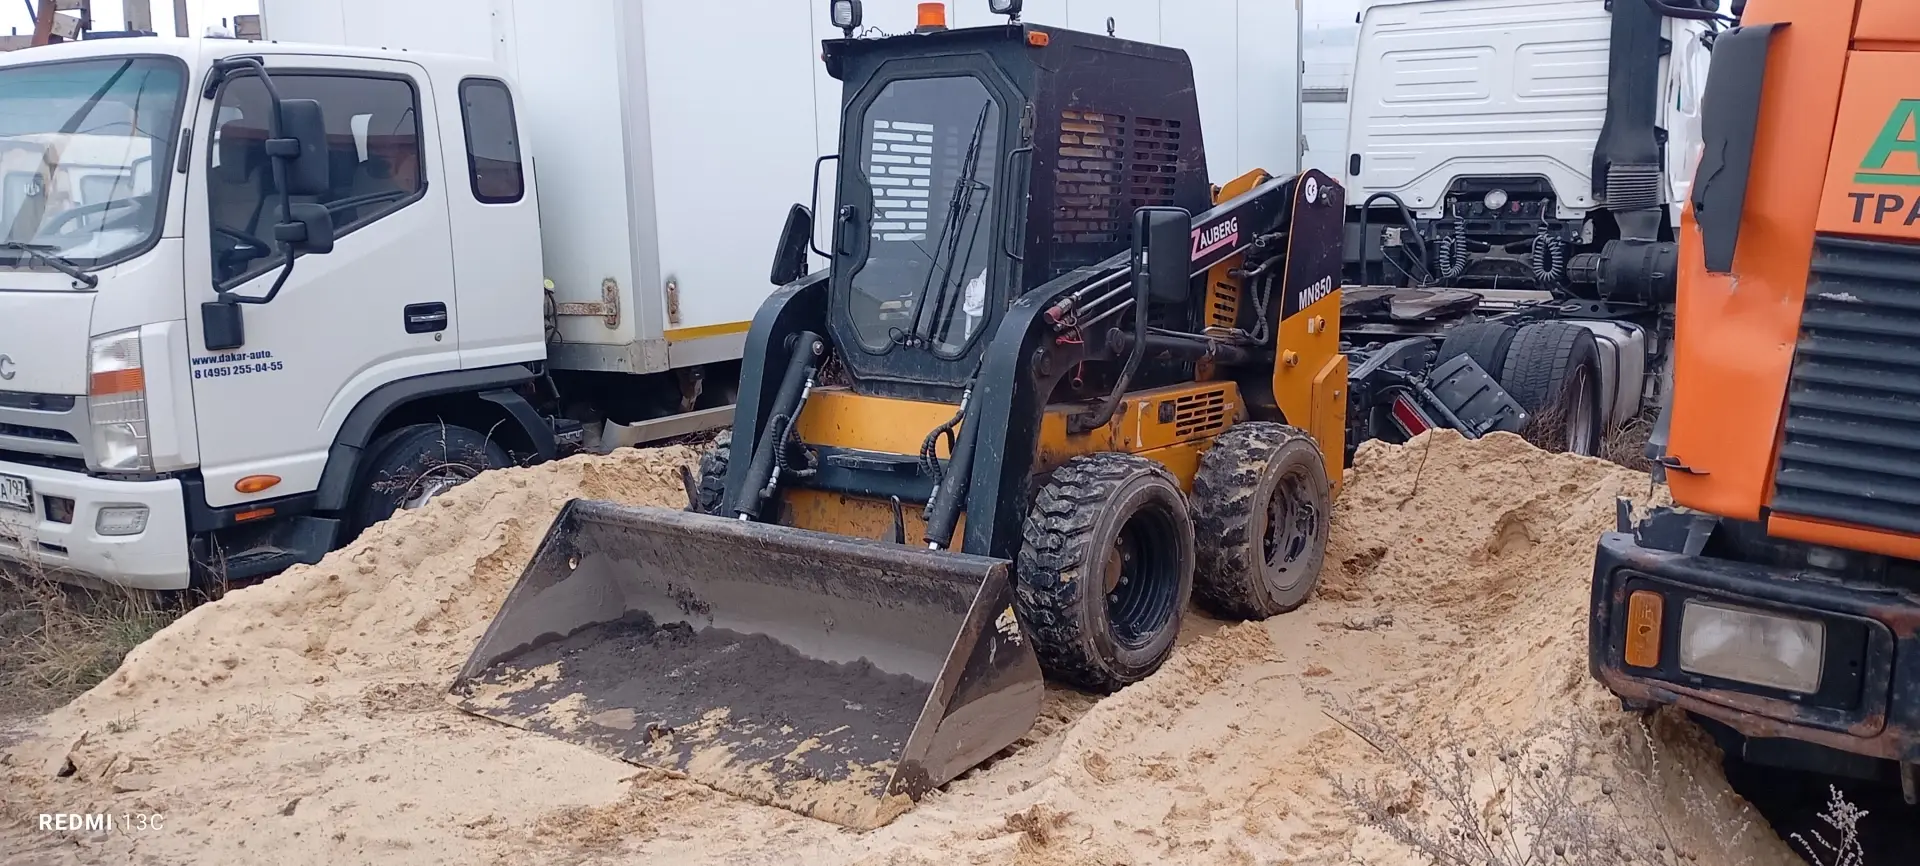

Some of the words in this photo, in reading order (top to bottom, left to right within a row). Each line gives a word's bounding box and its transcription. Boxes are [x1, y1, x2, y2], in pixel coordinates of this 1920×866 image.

[1191, 216, 1239, 262] ZAUBERG
[1299, 275, 1332, 311] MN850
[194, 370, 201, 379] 8
[203, 366, 231, 378] (495)
[233, 361, 283, 375] 255-04-55
